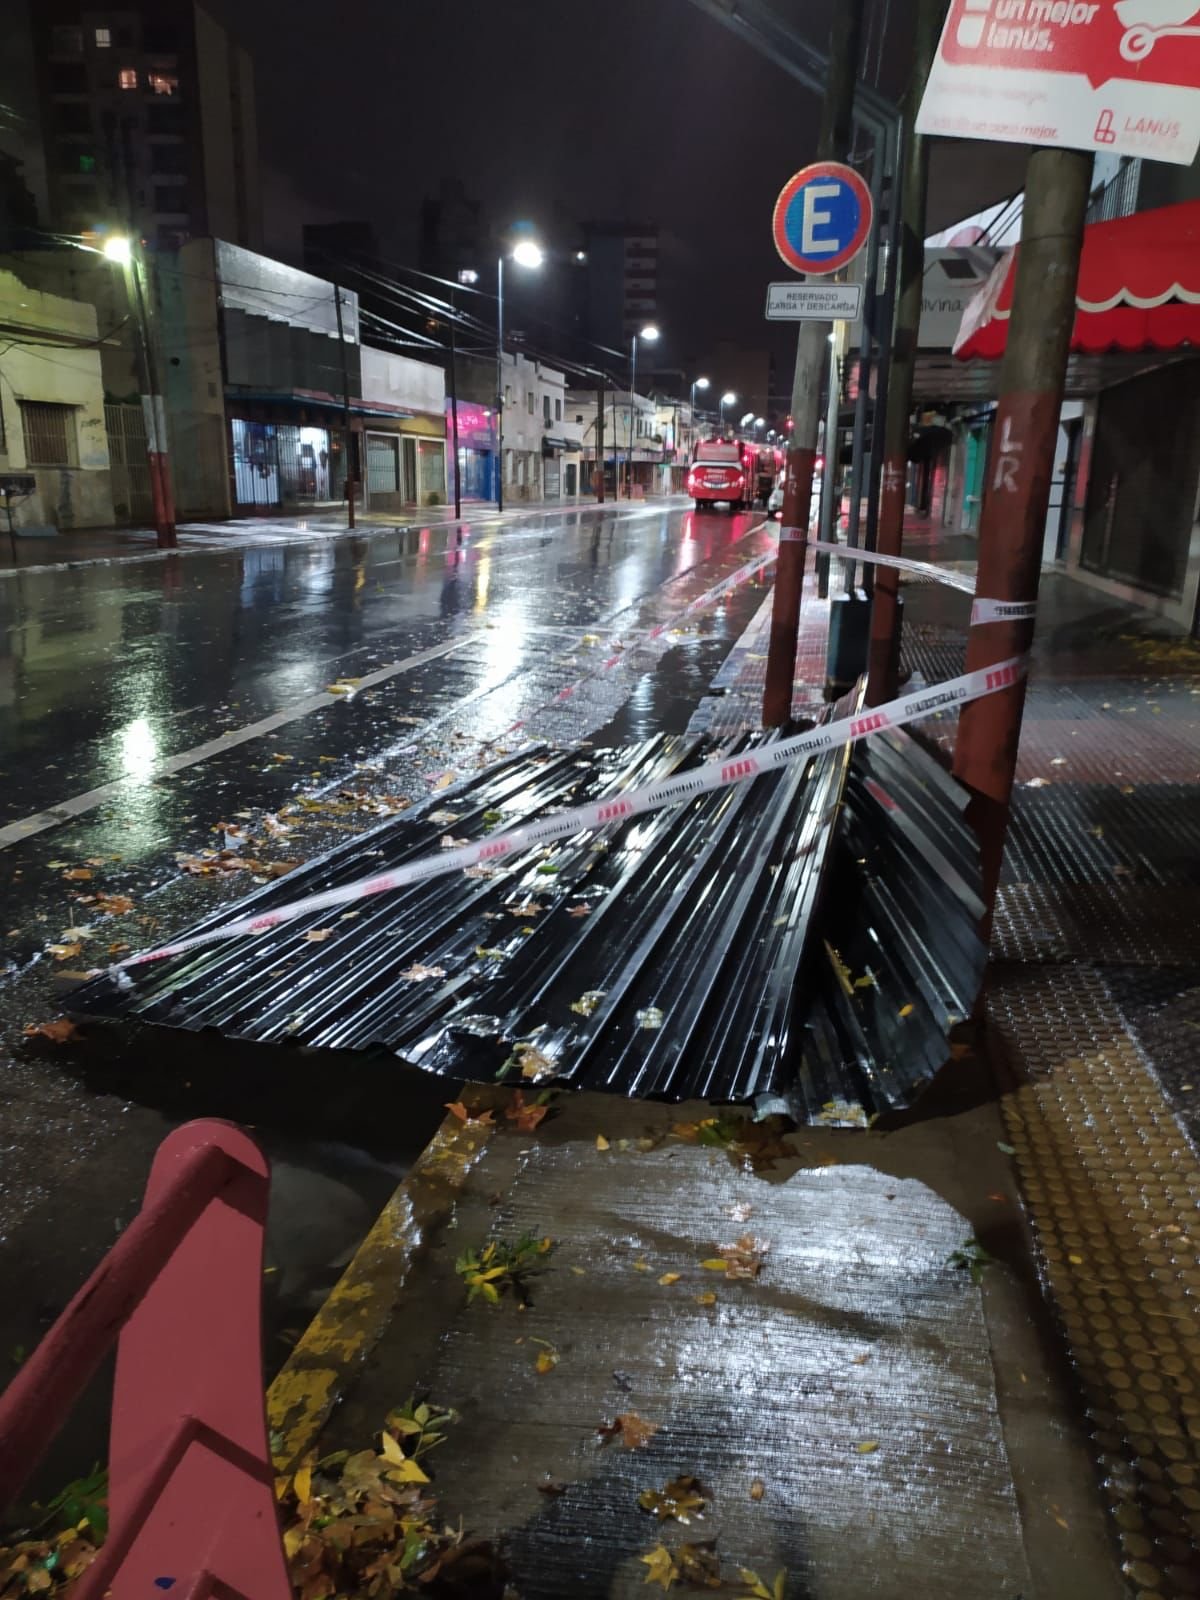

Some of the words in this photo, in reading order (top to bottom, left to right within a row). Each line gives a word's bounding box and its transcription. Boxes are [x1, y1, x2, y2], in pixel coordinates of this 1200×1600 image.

[995, 0, 1025, 20] un
[1026, 0, 1100, 28] mejor
[802, 185, 840, 254] E
[786, 292, 839, 302] RESERVADO
[769, 302, 797, 311] CARGA
[800, 302, 806, 311] Y
[807, 302, 856, 312] DESCARGA
